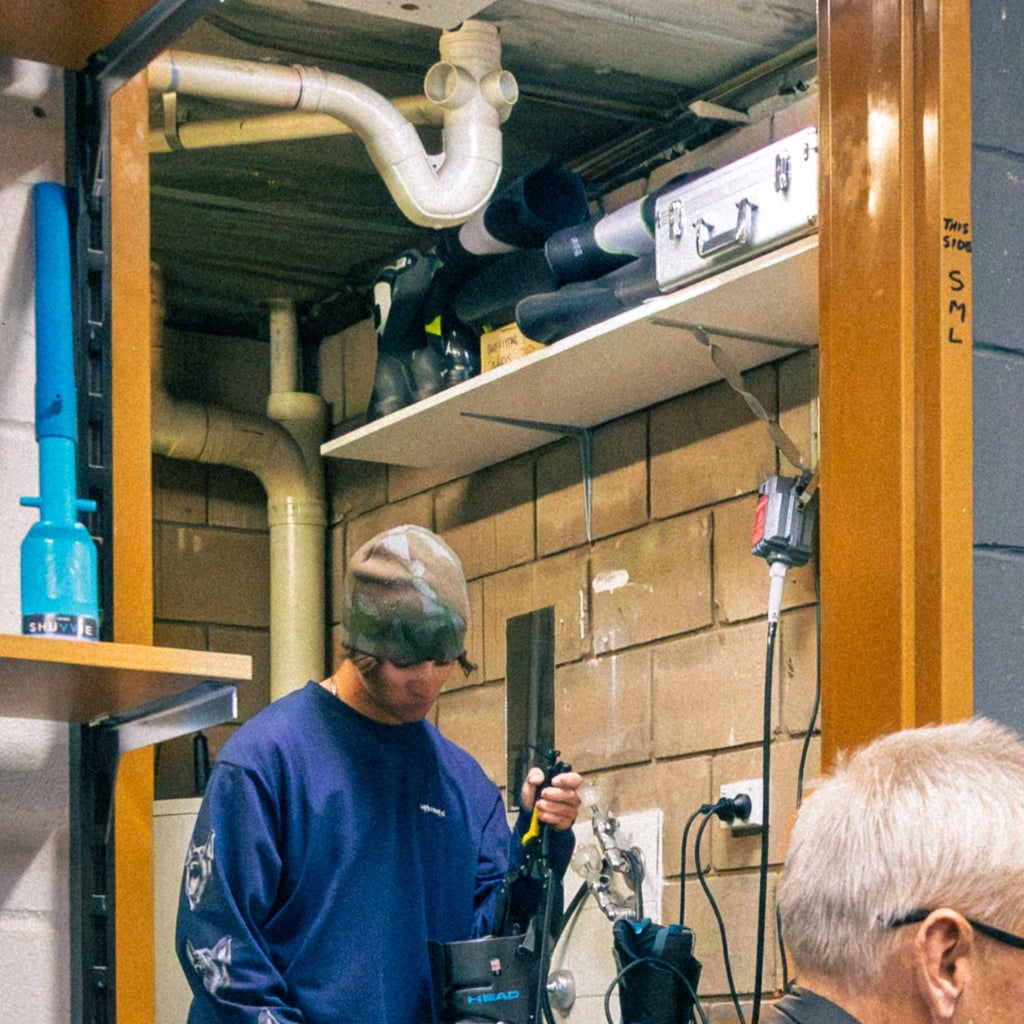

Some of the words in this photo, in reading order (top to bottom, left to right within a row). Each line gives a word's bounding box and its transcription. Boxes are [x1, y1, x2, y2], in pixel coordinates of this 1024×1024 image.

[943, 217, 969, 234] THIS
[943, 235, 972, 253] SIDE
[948, 270, 965, 292] S
[948, 300, 967, 323] M
[948, 327, 963, 344] L
[467, 990, 520, 1004] HEAD
